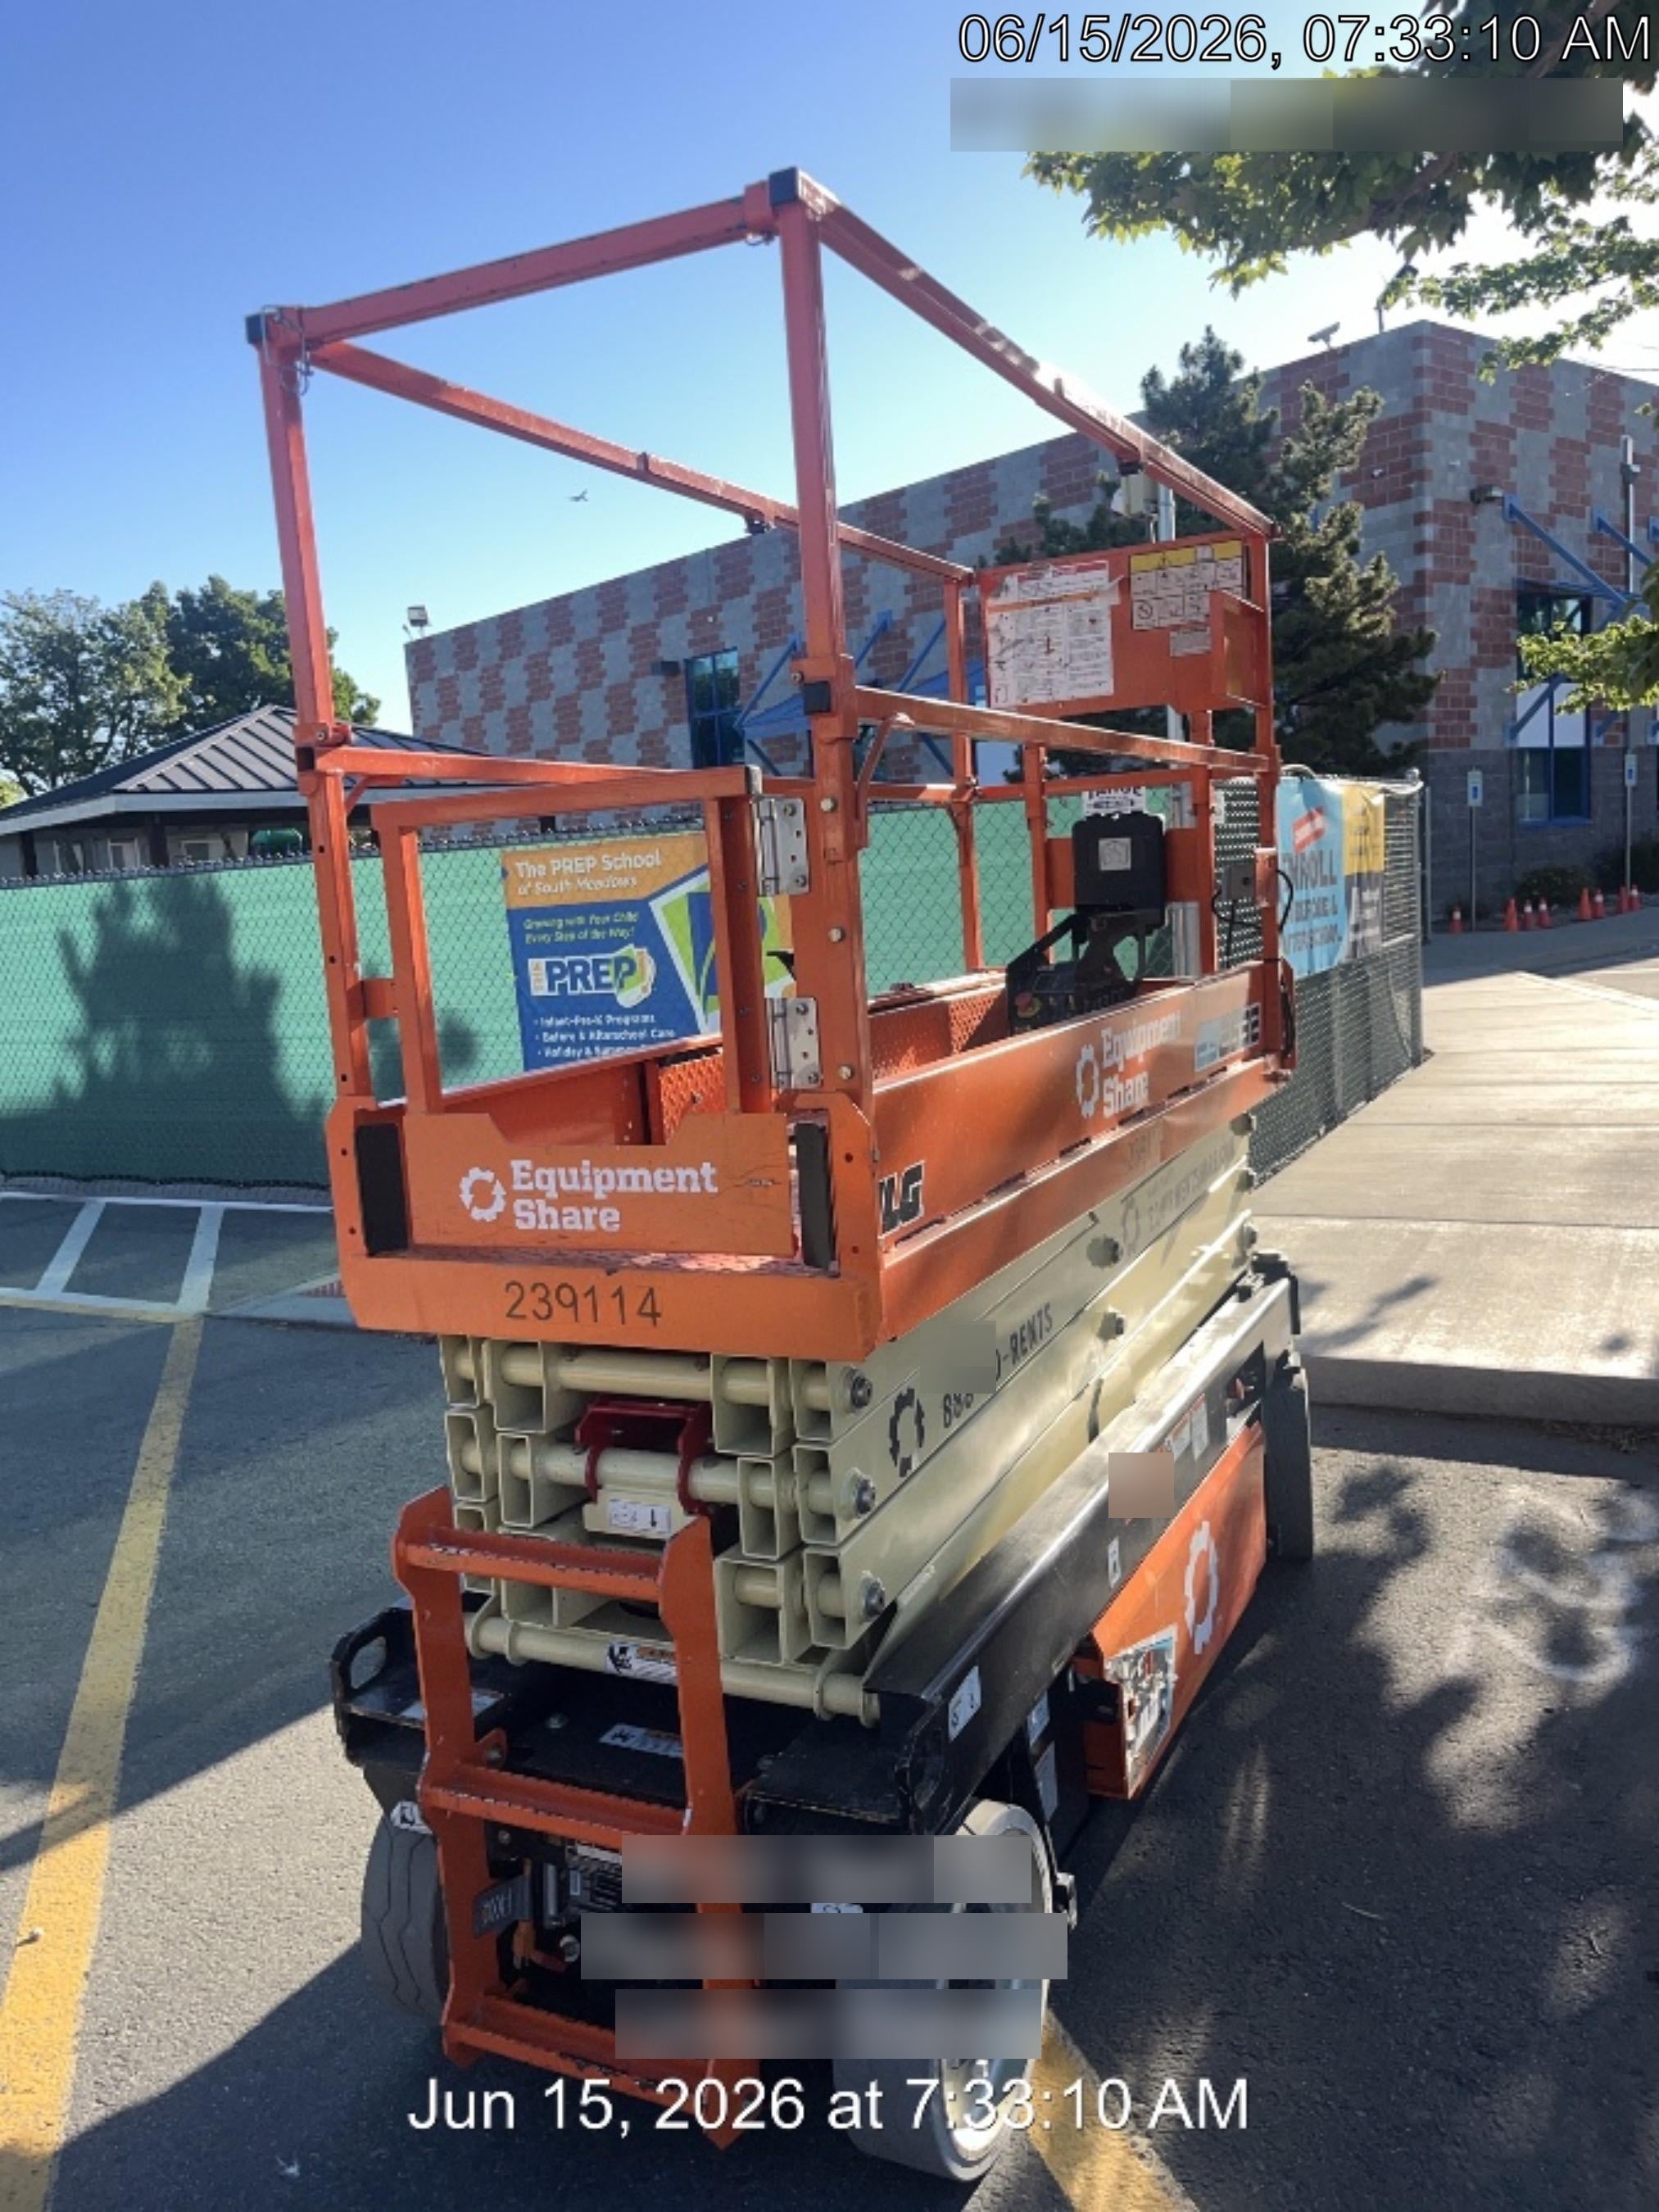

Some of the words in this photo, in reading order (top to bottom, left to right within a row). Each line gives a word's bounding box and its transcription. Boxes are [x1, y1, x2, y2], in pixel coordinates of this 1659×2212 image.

[515, 861, 546, 878] The
[551, 855, 597, 875] PREP
[602, 848, 661, 871] School
[518, 882, 532, 895] of
[535, 879, 571, 895] South
[525, 932, 551, 944] Every
[546, 956, 637, 995] PREP
[542, 1031, 575, 1043] Before
[1103, 1070, 1149, 1119] Share
[510, 1159, 718, 1199] Equipment
[513, 1199, 621, 1232] Share
[505, 1281, 662, 1326] 239114
